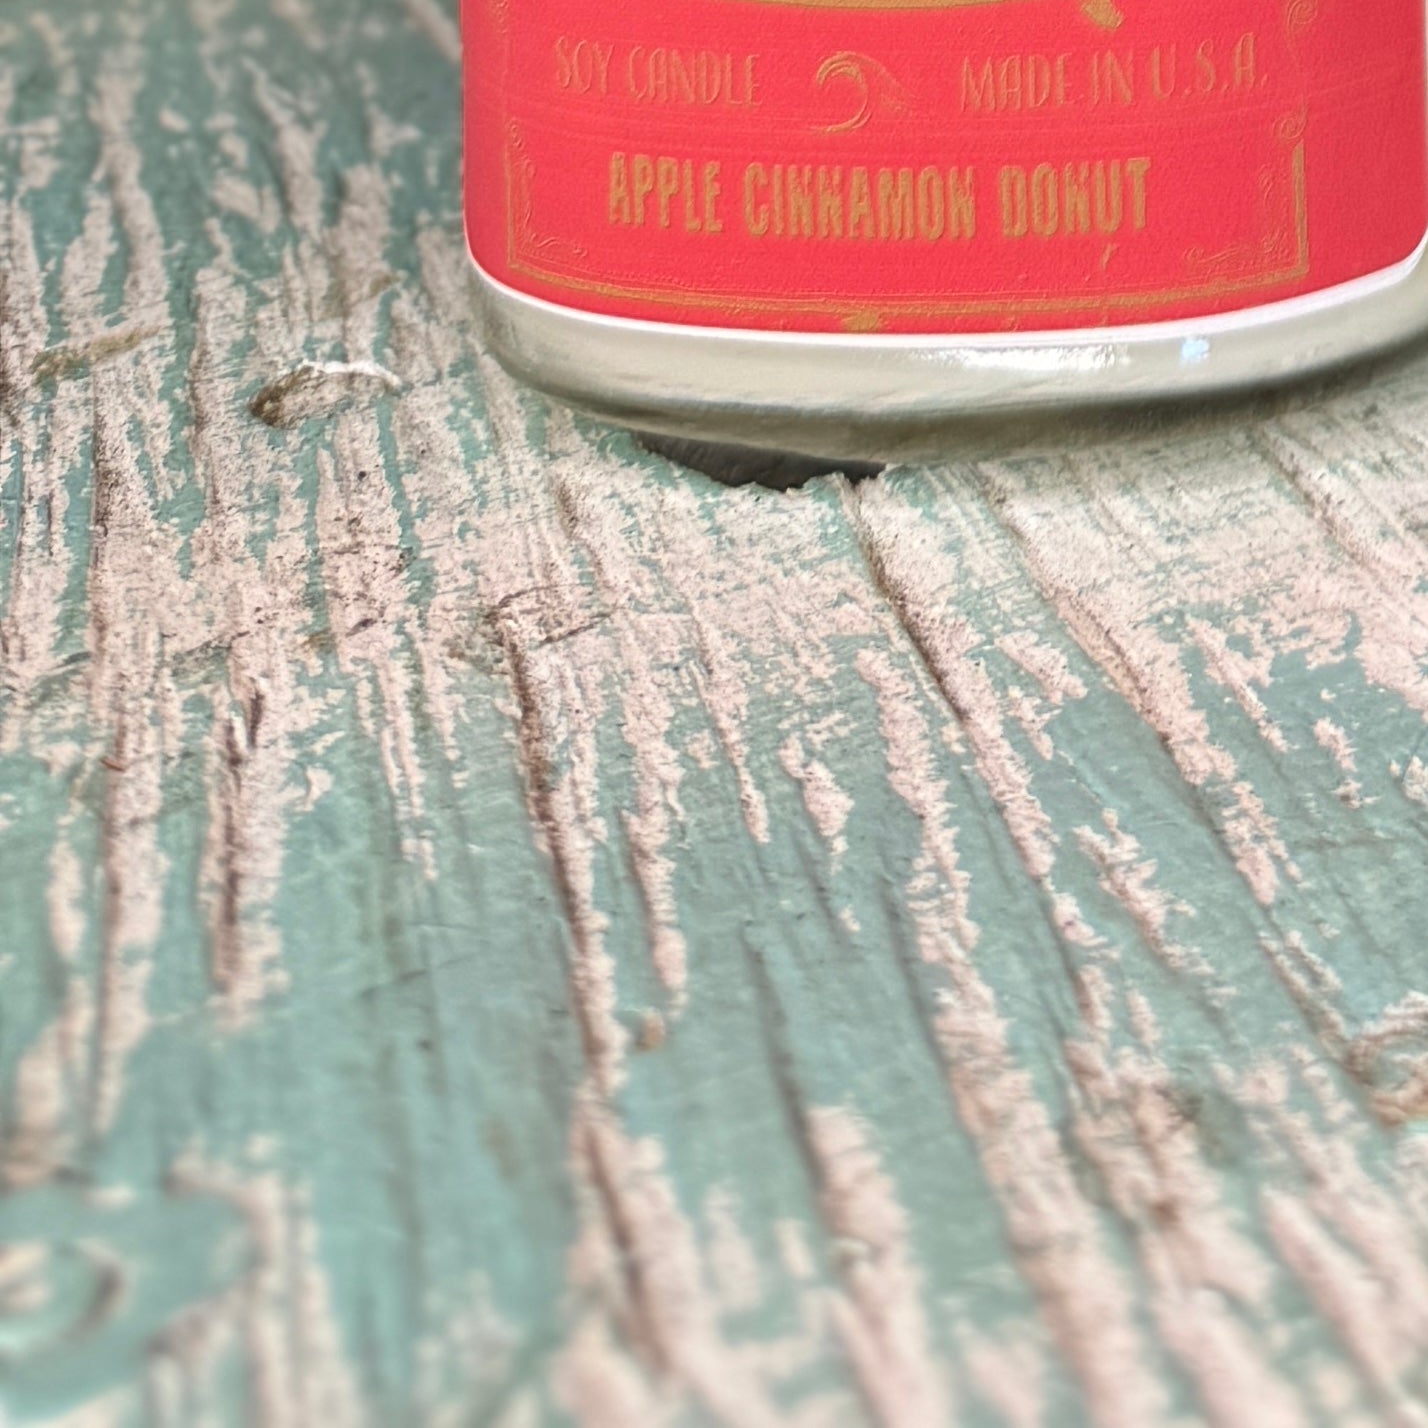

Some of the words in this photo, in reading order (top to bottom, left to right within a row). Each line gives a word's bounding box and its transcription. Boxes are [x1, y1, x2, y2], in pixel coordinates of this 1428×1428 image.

[556, 35, 614, 88] SOY
[625, 45, 764, 109] CANDLE
[960, 53, 1077, 110] MADE
[1084, 51, 1132, 106] IN
[1149, 31, 1270, 99] U.S.A.
[609, 152, 724, 233] APPLE
[744, 161, 977, 239] CINNAMON
[1001, 155, 1151, 236] DONUT
